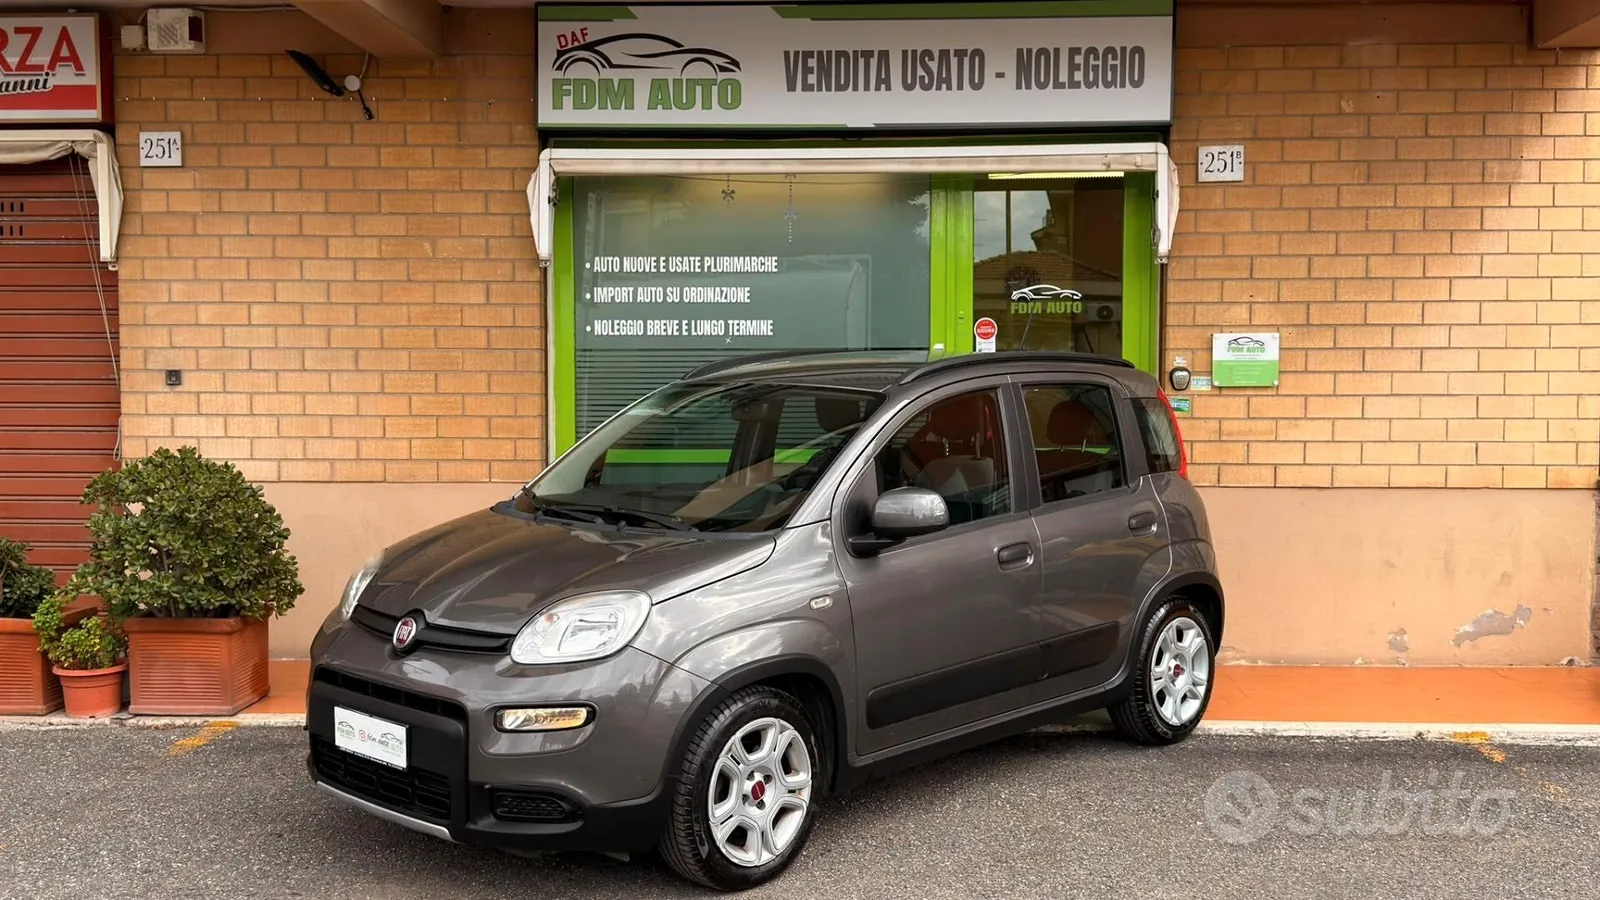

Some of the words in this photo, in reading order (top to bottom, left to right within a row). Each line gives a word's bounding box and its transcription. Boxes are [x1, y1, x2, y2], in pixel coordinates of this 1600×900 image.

[556, 27, 589, 49] DAF
[783, 49, 892, 92] VENDITA
[901, 48, 985, 91] USATO
[1015, 45, 1145, 91] NOLEGGIO
[551, 78, 635, 110] FDM
[647, 78, 742, 110] AUTO
[593, 256, 620, 273] AUTO
[623, 256, 657, 273] NUOVE
[659, 256, 666, 273] E
[669, 256, 701, 273] USATE
[704, 256, 778, 273] PLURIMARCHE
[593, 287, 634, 303] IMPORT
[637, 287, 663, 303] AUTO
[666, 287, 680, 303] SU
[683, 287, 750, 303] ORDINAZIONE
[1010, 302, 1042, 314] FDM
[1046, 301, 1082, 314] AUTO
[594, 319, 644, 336] NOLEGGIO
[647, 319, 679, 336] BREVE
[682, 319, 688, 336] E
[691, 319, 725, 336] LUNGO
[728, 319, 773, 336] TERMINE
[1246, 346, 1266, 354] AUTO
[397, 625, 412, 641] FIAT
